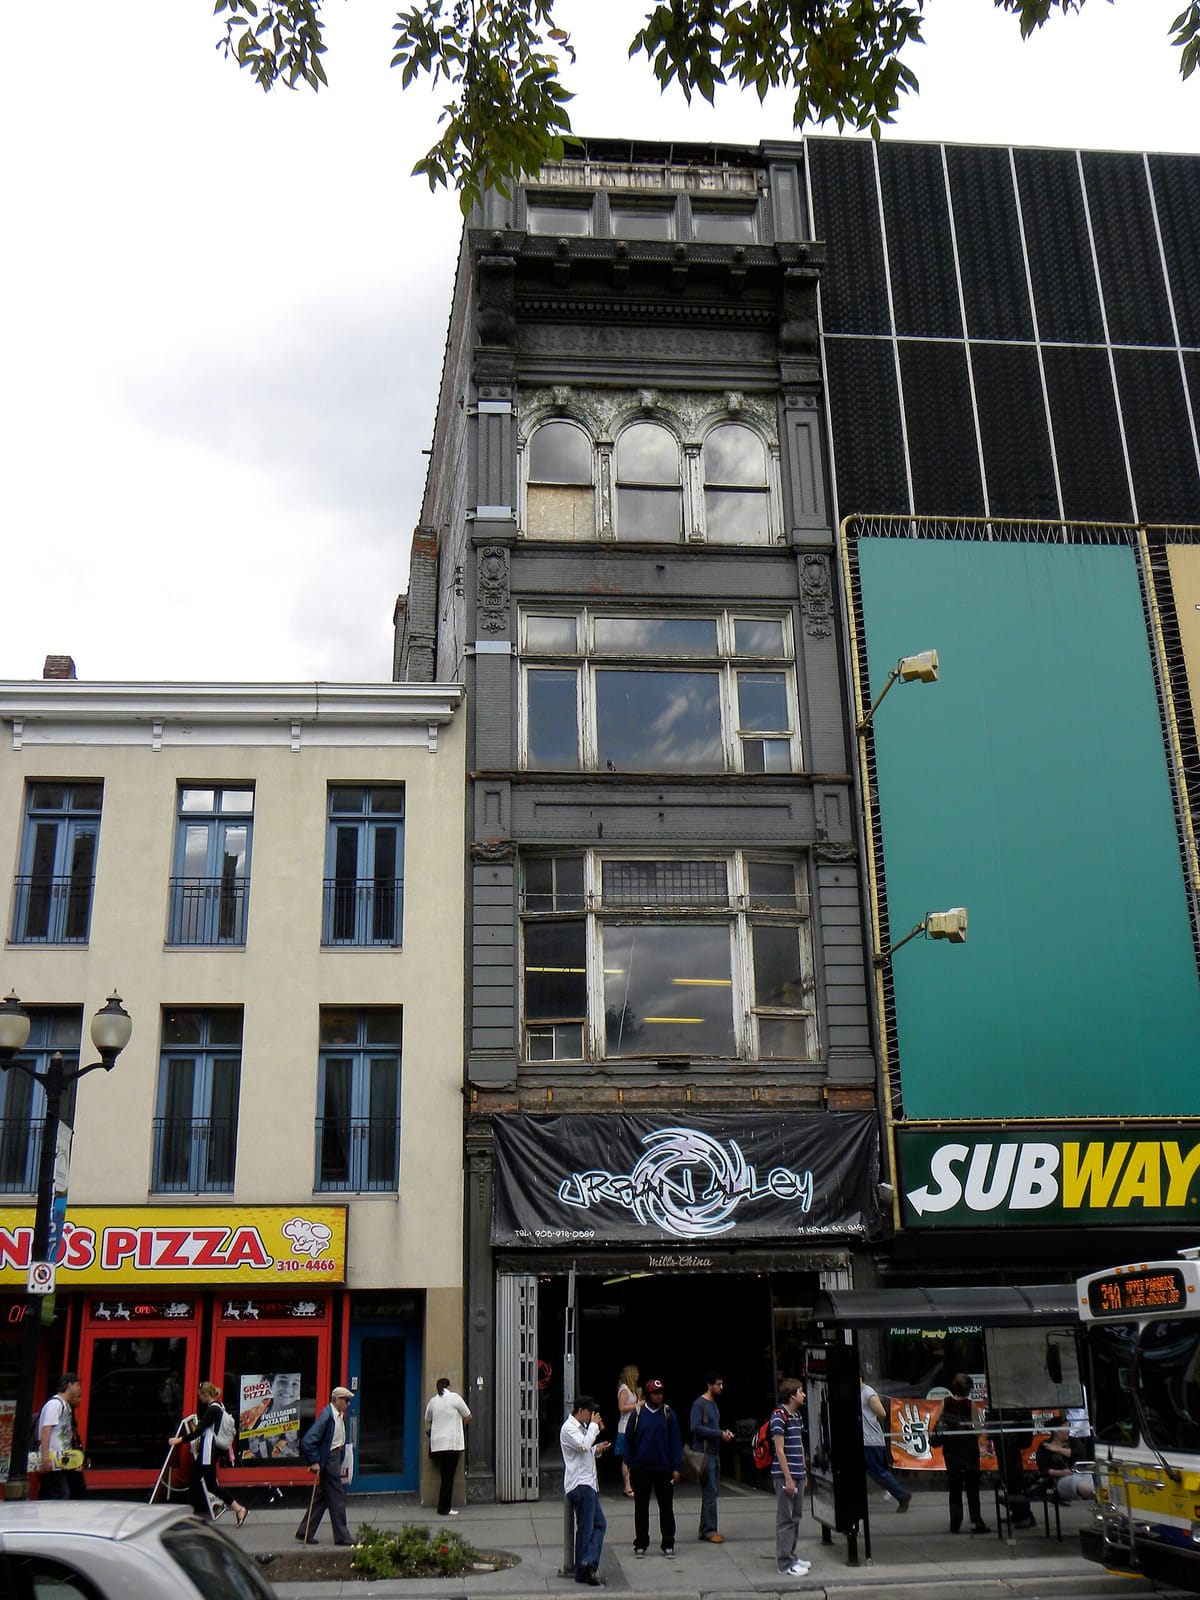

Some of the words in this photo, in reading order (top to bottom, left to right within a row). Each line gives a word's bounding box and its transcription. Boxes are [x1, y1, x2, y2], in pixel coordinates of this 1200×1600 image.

[906, 1141, 1200, 1217] SUBWAY
[103, 1229, 268, 1268] PIZZA
[277, 1259, 335, 1272] 310-4466
[134, 1305, 157, 1314] OPEN
[243, 1389, 272, 1400] PIZZA
